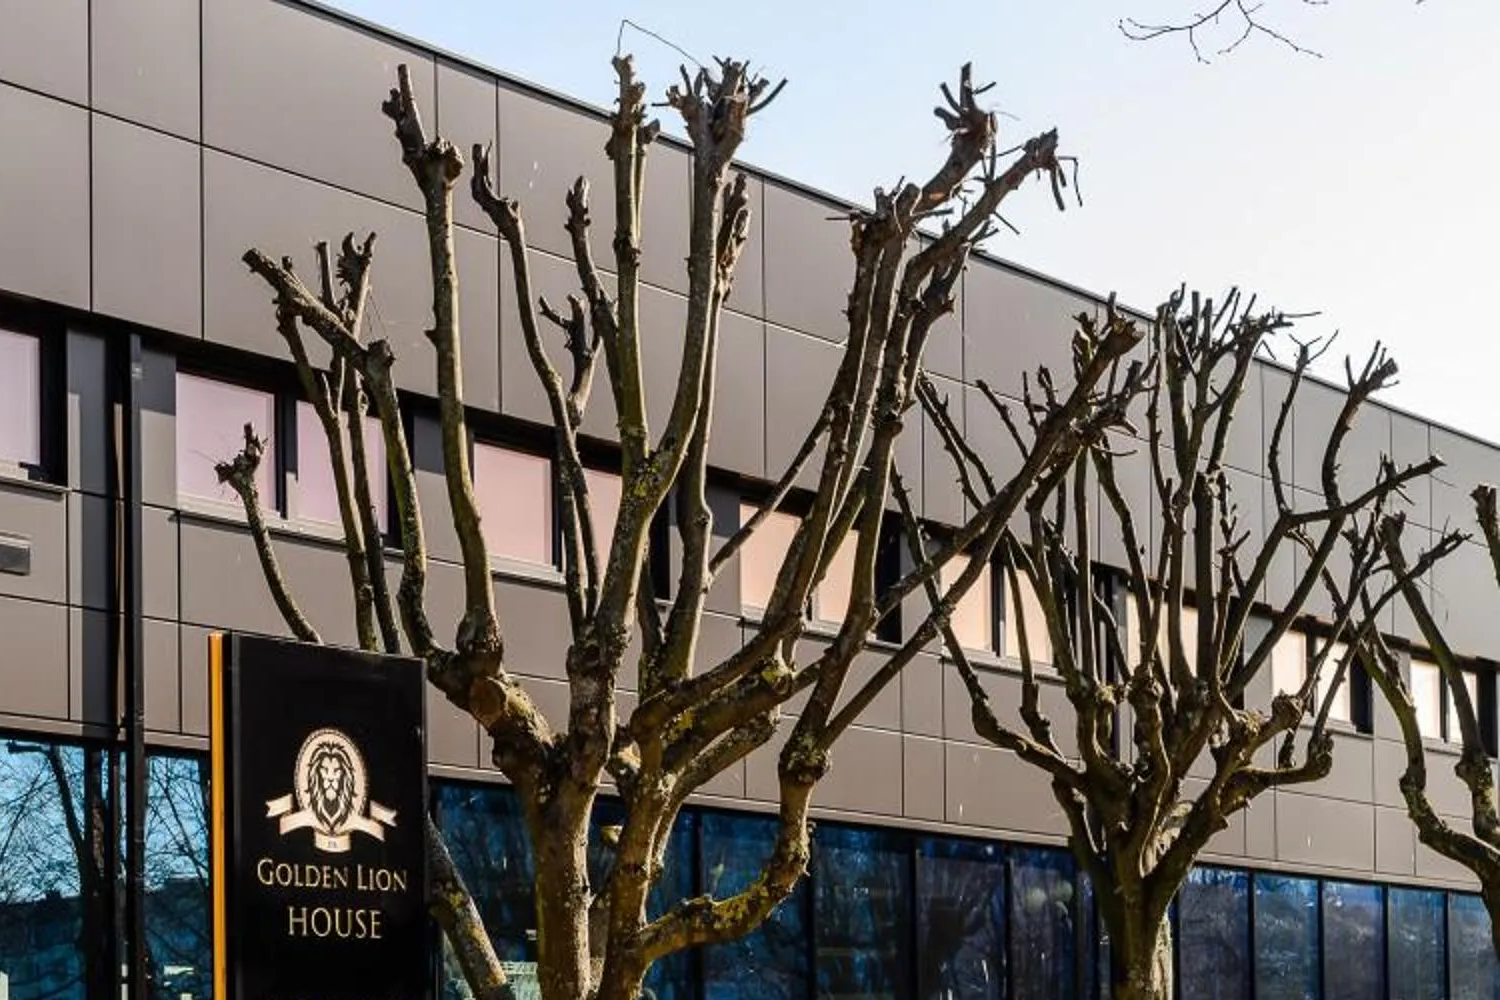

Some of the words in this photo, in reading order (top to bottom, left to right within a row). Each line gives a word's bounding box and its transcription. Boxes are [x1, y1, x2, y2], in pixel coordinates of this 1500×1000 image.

[257, 858, 349, 889] GOLDEN
[357, 863, 408, 892] LION
[287, 906, 383, 939] HOUSE
